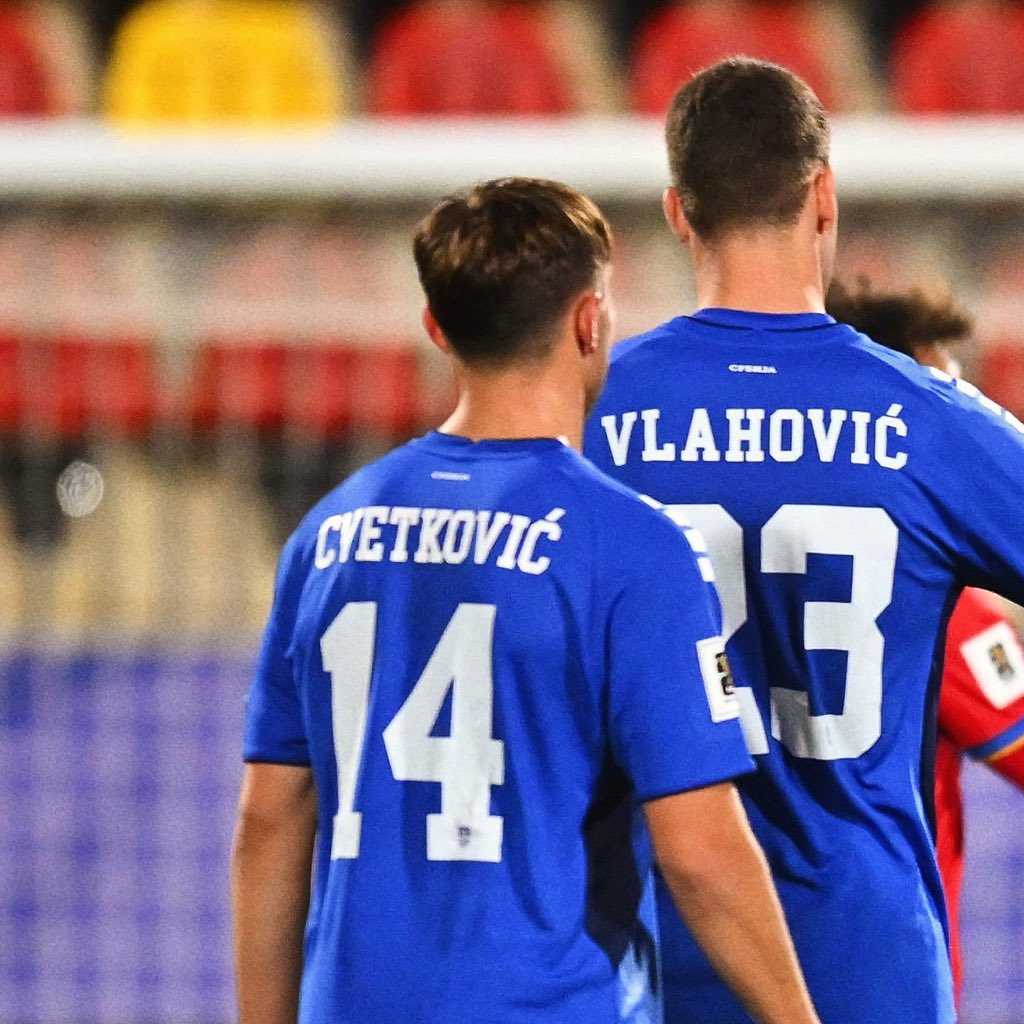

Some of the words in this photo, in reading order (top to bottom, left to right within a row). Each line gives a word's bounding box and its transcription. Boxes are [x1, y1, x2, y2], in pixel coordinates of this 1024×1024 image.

[601, 403, 908, 470] VLAHOVIĆ
[314, 507, 566, 575] CVETKOVIĆ
[320, 601, 505, 862] 14
